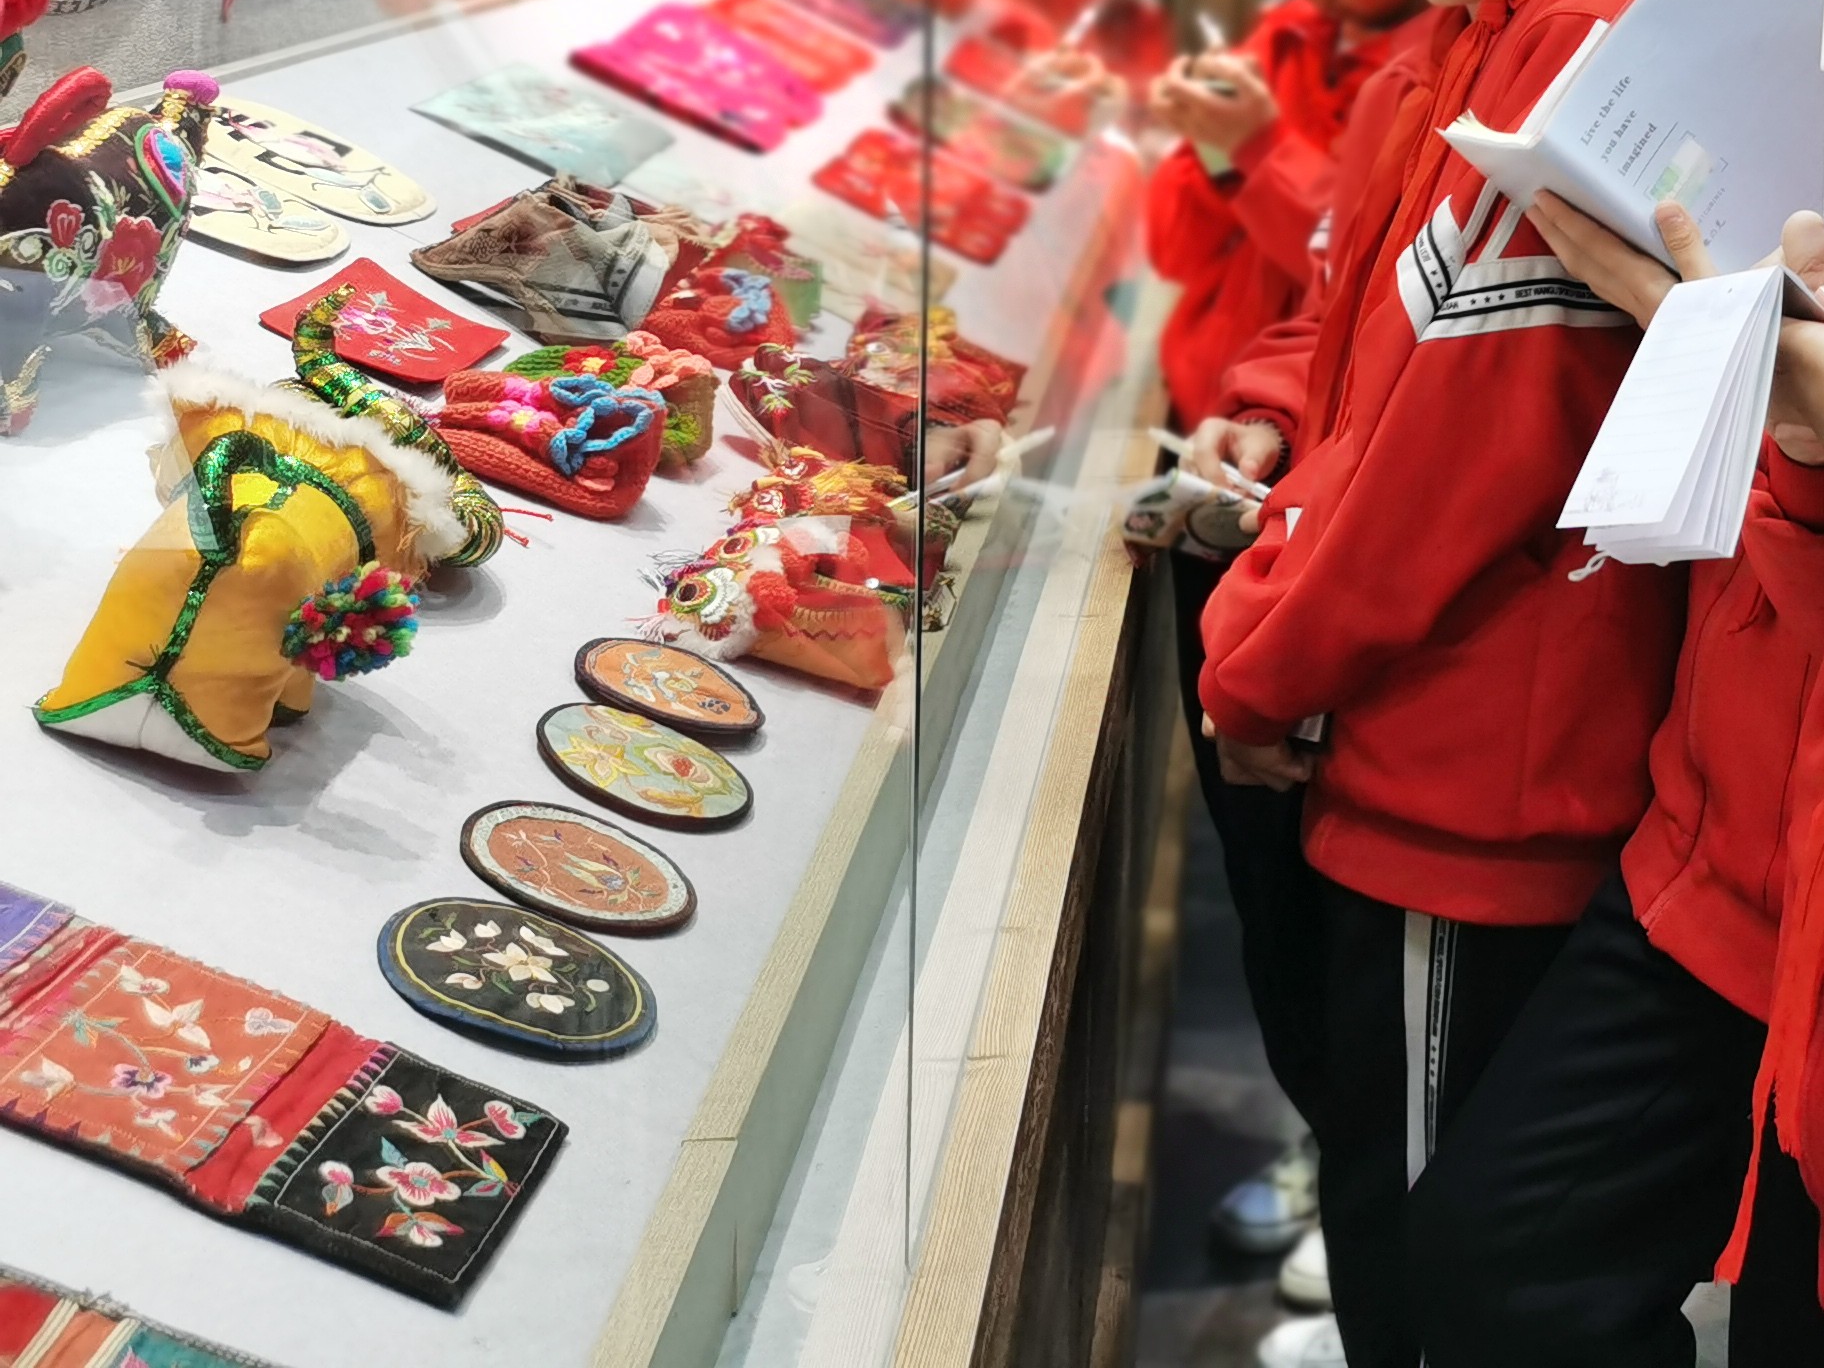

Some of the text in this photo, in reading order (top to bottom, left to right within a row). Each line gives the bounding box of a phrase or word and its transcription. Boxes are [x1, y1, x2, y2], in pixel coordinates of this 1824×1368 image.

[1578, 73, 1632, 146] Live the life
[1598, 107, 1637, 163] you have
[1615, 121, 1658, 177] imagined
